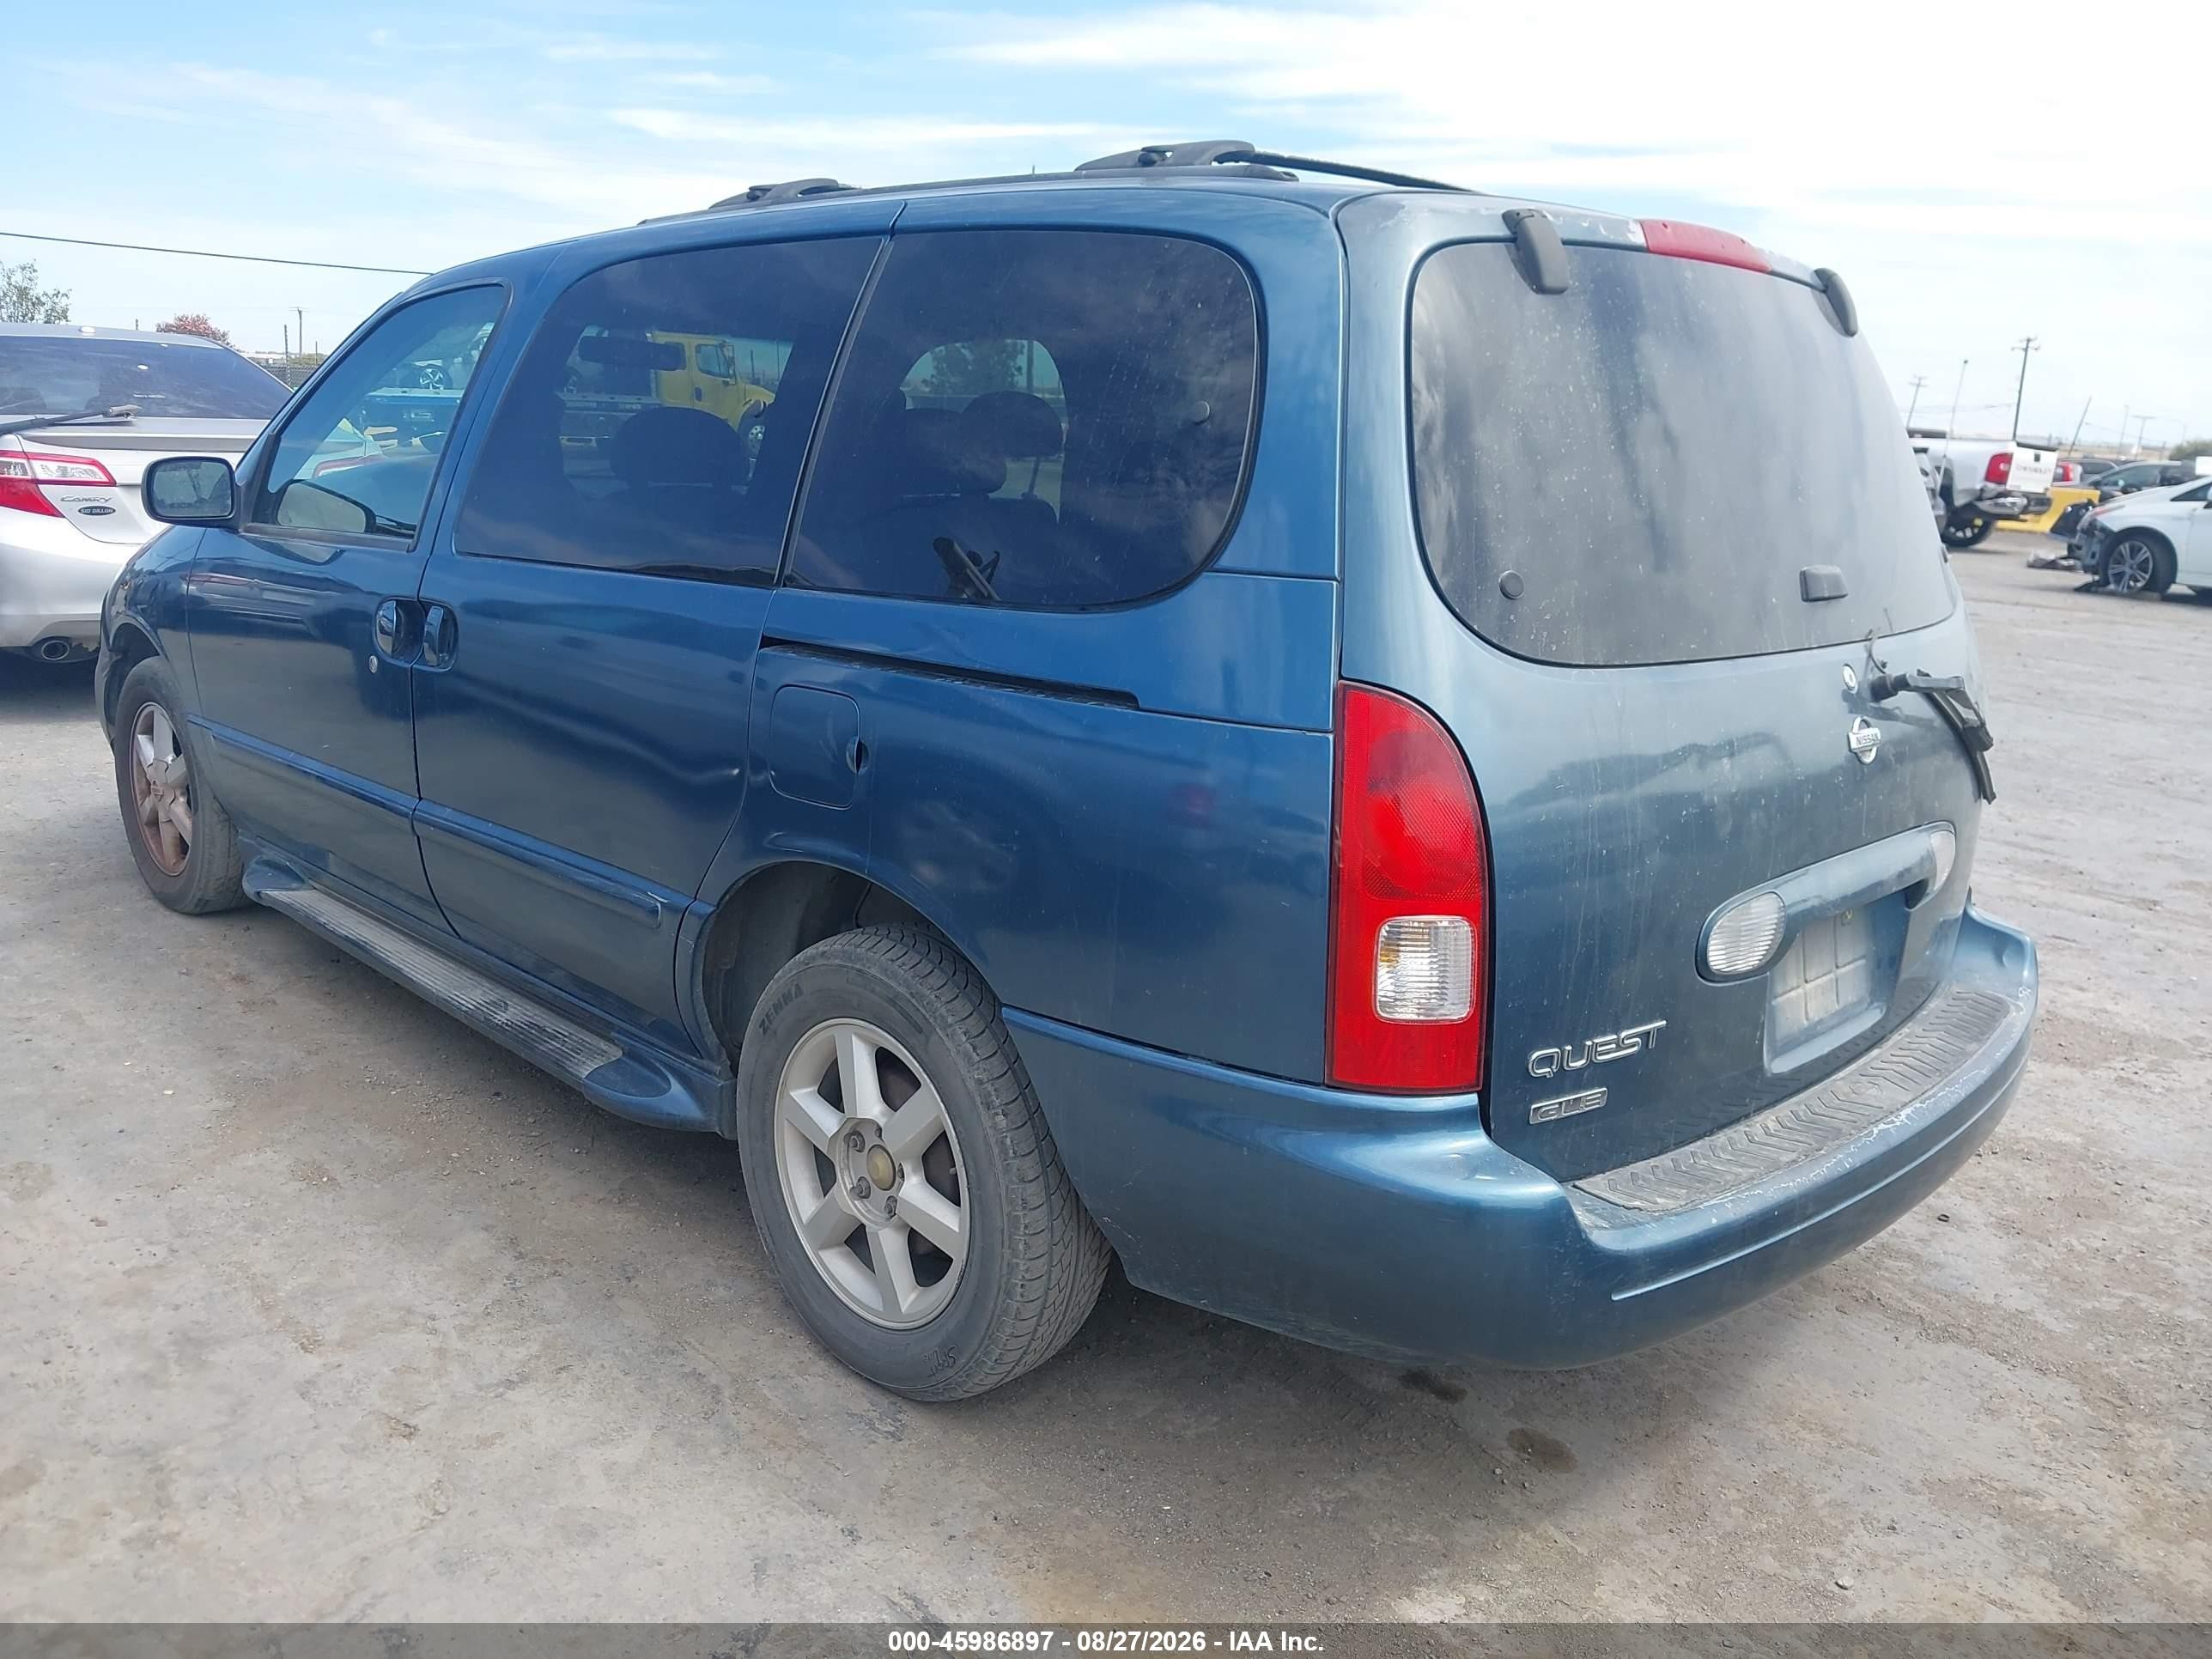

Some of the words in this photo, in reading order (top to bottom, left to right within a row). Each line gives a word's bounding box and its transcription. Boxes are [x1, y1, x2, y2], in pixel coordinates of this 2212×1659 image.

[1856, 732, 1879, 746] NISSAN
[1528, 1019, 1668, 1079] QUEST
[1536, 1092, 1603, 1121] GLE
